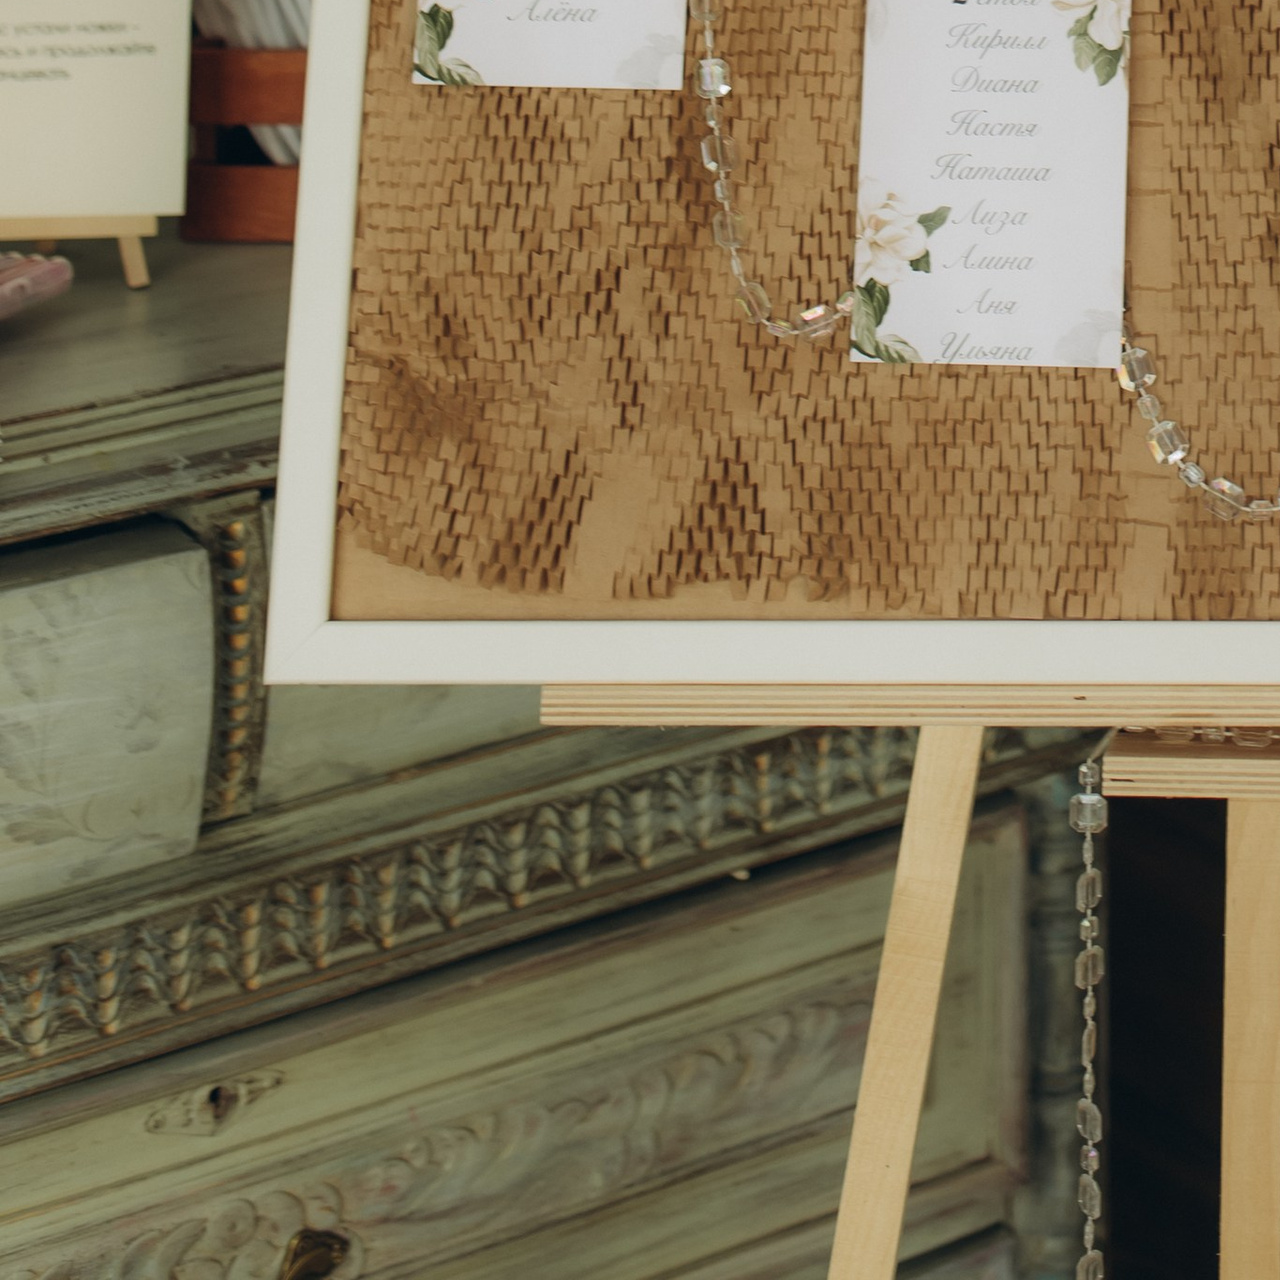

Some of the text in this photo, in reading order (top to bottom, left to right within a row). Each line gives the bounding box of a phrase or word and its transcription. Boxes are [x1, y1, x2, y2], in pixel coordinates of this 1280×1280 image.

[945, 23, 1047, 59] Кирилл
[951, 66, 1039, 93] Диана
[946, 110, 1038, 137] Настя
[930, 153, 1051, 181] Наташа
[950, 199, 1028, 235] Лиза
[942, 244, 1034, 270] Алина
[956, 288, 1017, 315] Аня
[932, 332, 1034, 364] Ульяна
